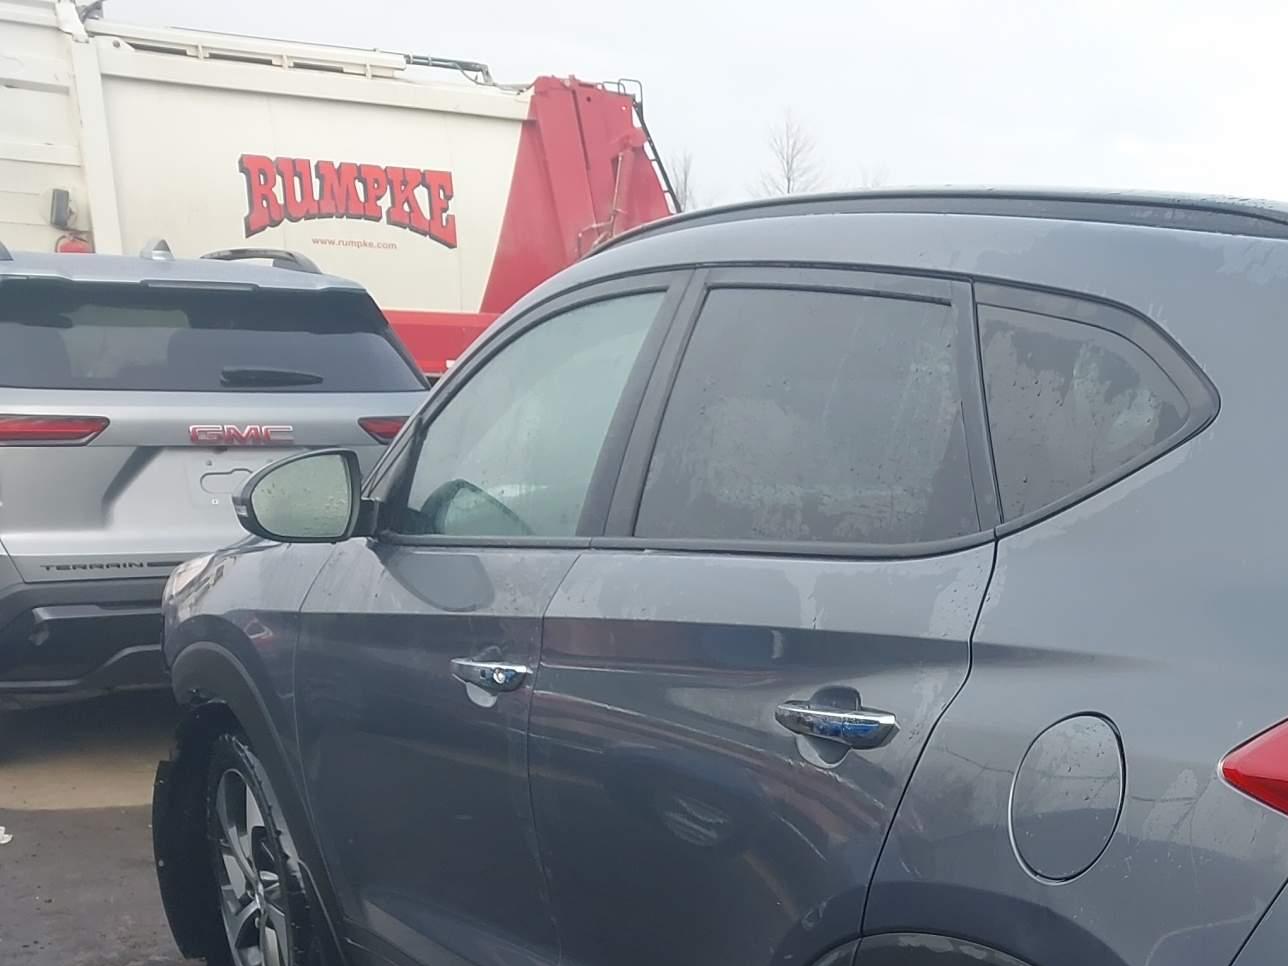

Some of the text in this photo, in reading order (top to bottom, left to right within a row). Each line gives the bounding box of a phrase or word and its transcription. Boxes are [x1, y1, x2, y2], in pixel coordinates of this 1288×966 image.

[238, 153, 457, 249] RUMPKE
[311, 236, 398, 250] www.rumpke.com
[188, 424, 295, 445] GMC
[40, 561, 145, 572] TERRAIN
